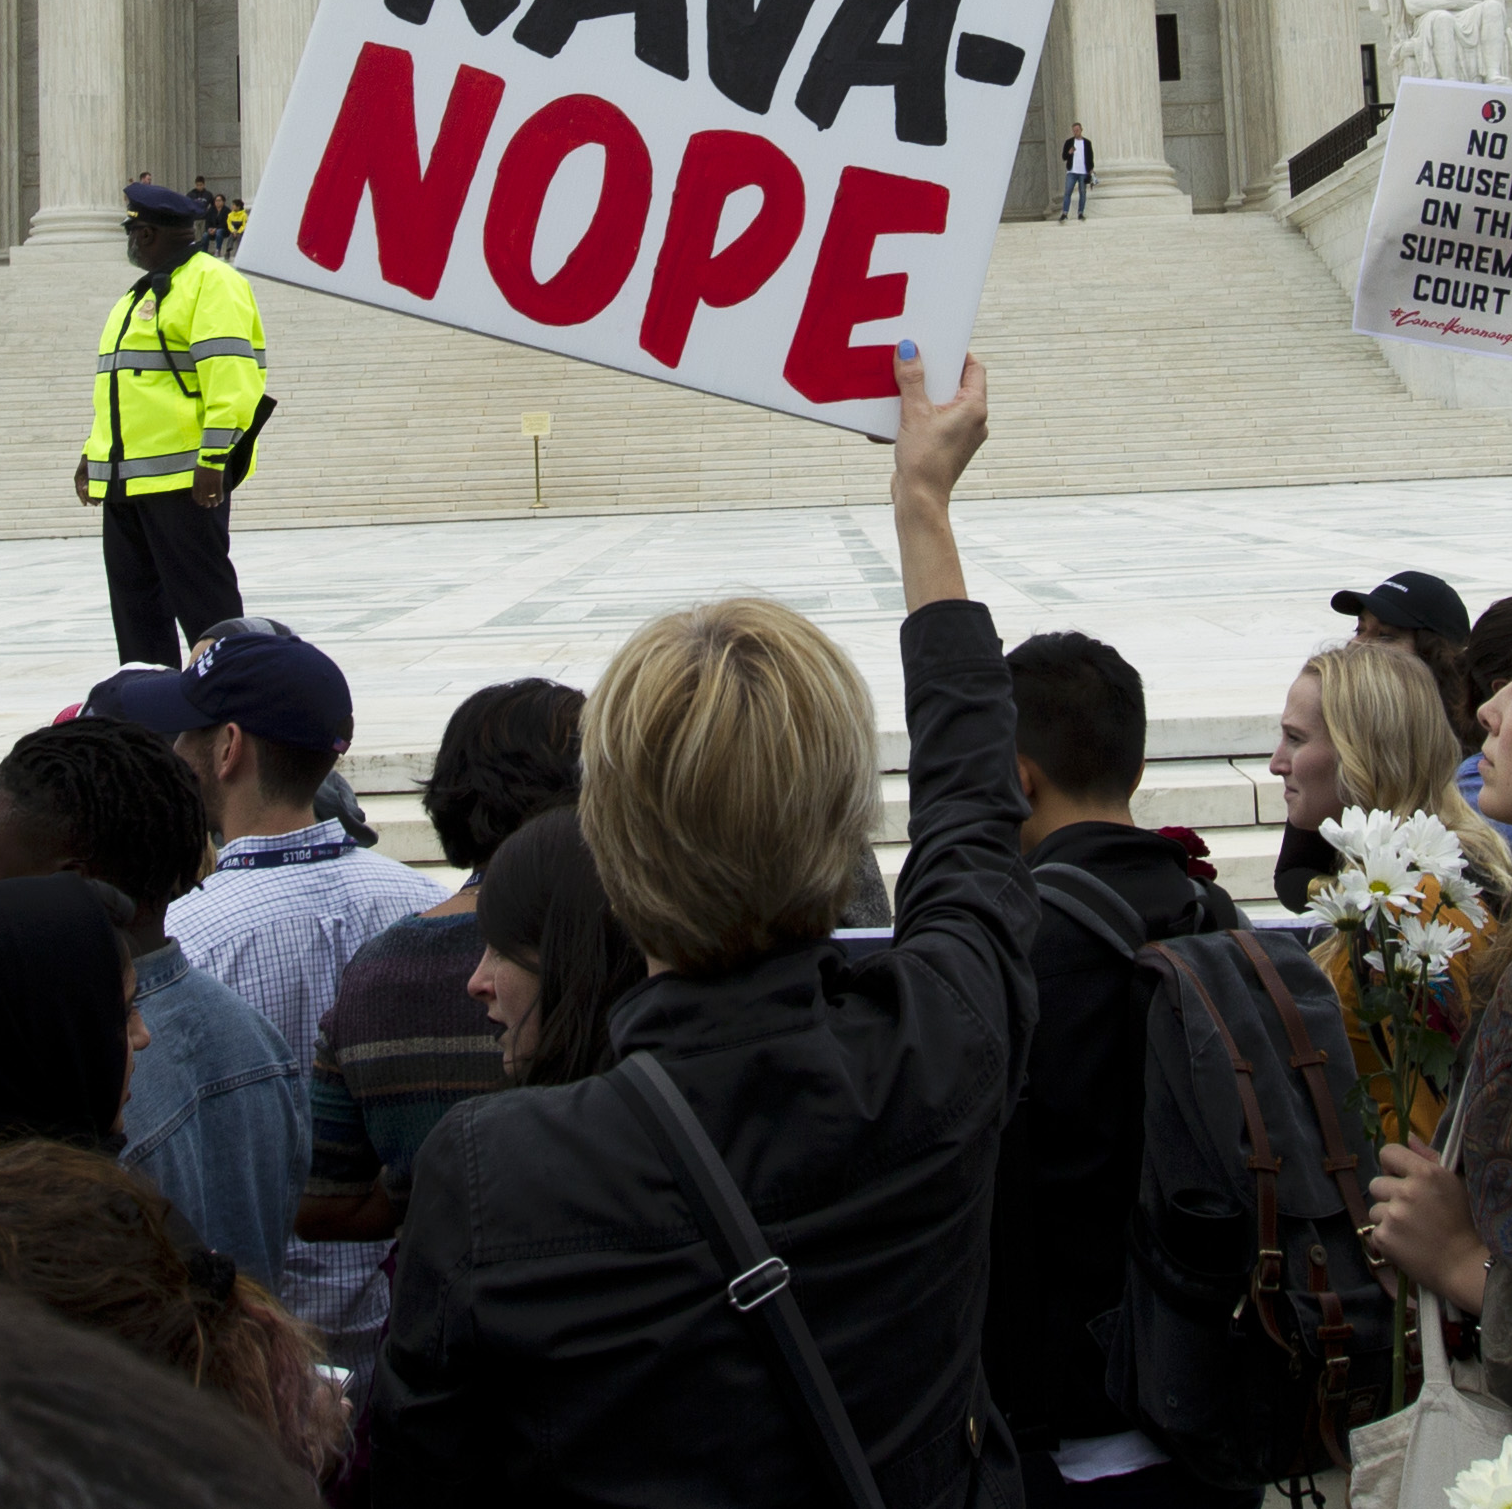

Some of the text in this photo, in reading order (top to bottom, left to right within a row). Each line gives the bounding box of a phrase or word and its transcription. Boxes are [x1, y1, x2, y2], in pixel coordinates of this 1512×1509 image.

[1467, 129, 1508, 161] NO
[297, 41, 951, 405] NOPE
[1420, 198, 1462, 230] ON
[1412, 274, 1511, 315] COURT
[282, 849, 311, 863] POLLS
